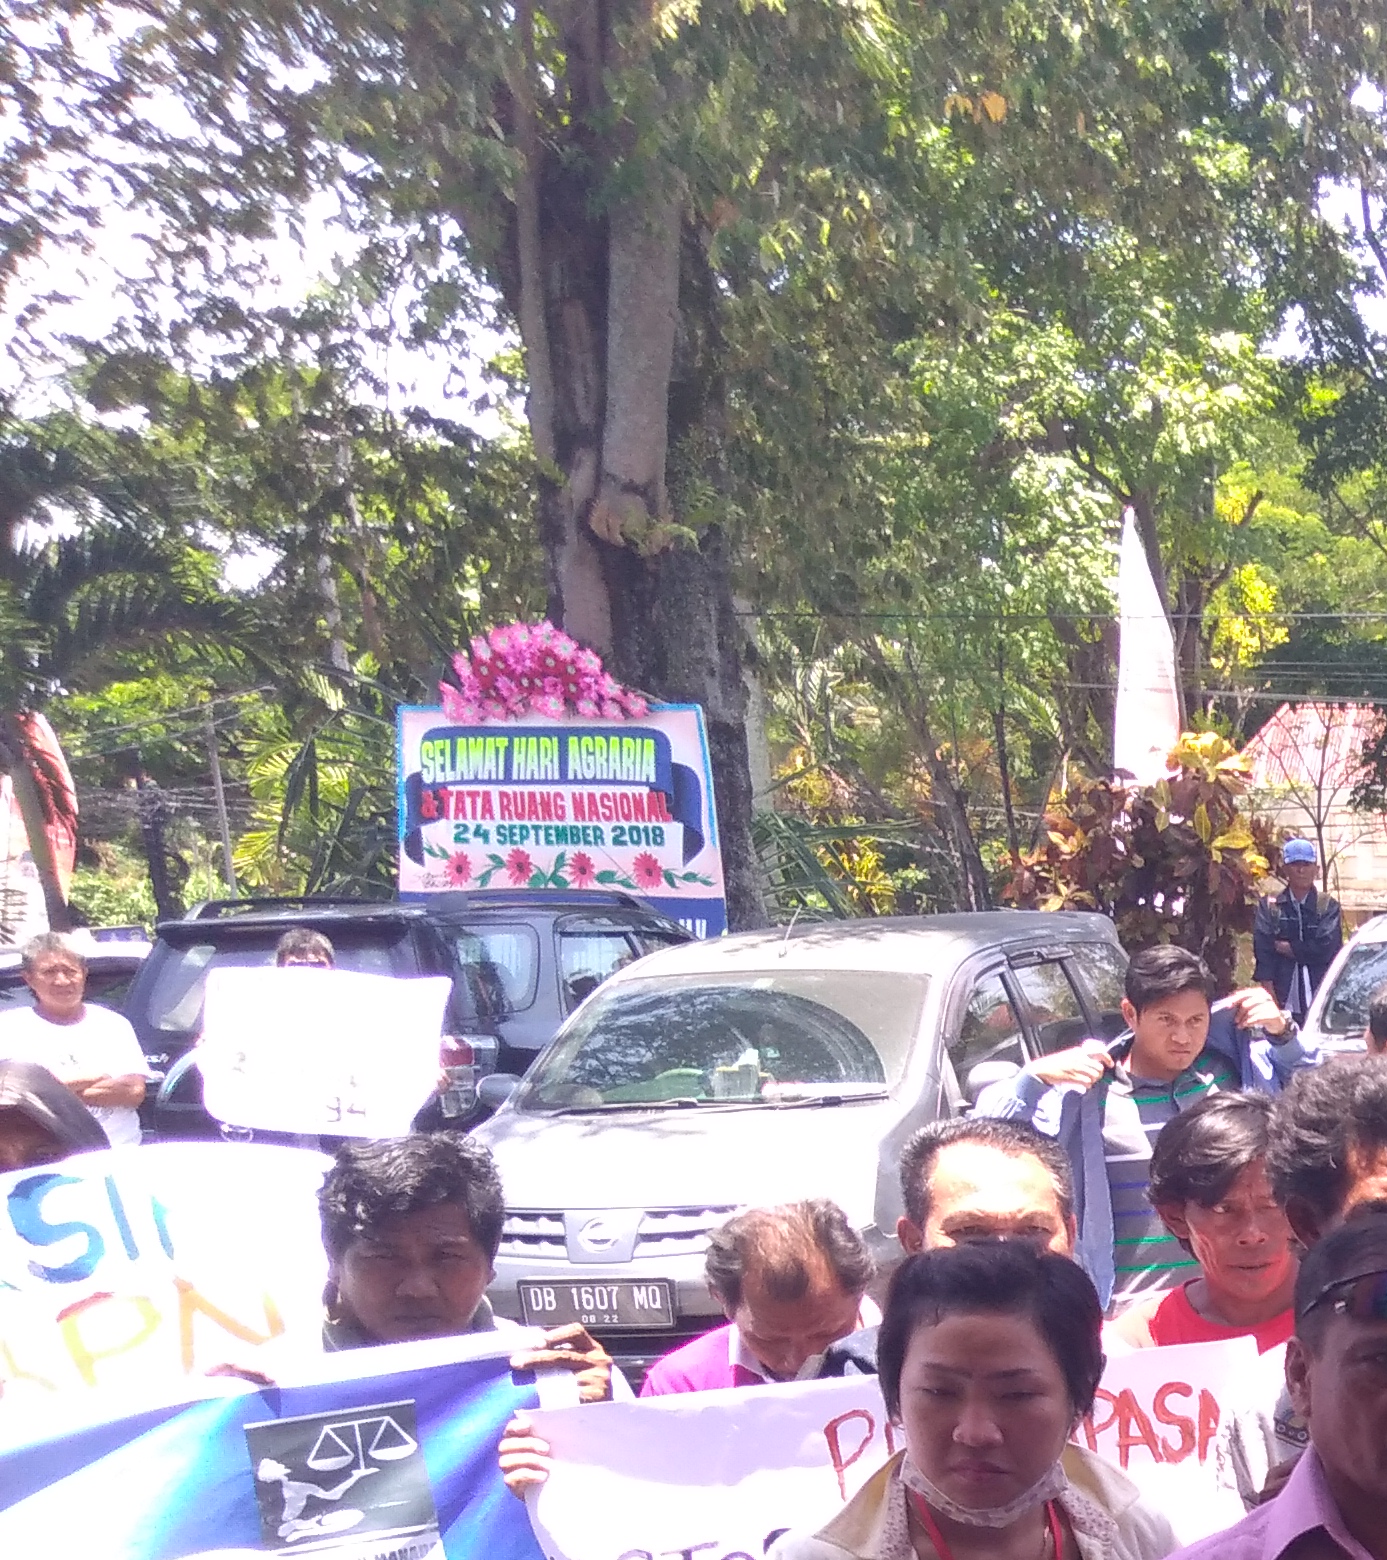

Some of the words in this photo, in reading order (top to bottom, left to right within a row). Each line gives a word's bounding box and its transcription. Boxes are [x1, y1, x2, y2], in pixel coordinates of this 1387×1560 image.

[420, 736, 509, 784] SELAMAT
[512, 735, 558, 782] HARI
[568, 735, 656, 783] AGRARIA
[420, 792, 438, 820] &
[440, 789, 495, 821] TATA
[500, 790, 567, 821] RUANG
[572, 789, 673, 822] NASIONAL
[453, 822, 491, 845] 24
[496, 820, 604, 846] SEPTEMBER
[611, 823, 665, 847] 2018
[529, 1287, 557, 1312] DB
[571, 1285, 620, 1311] 1607
[634, 1286, 663, 1312] MQ
[603, 1312, 620, 1324] 22
